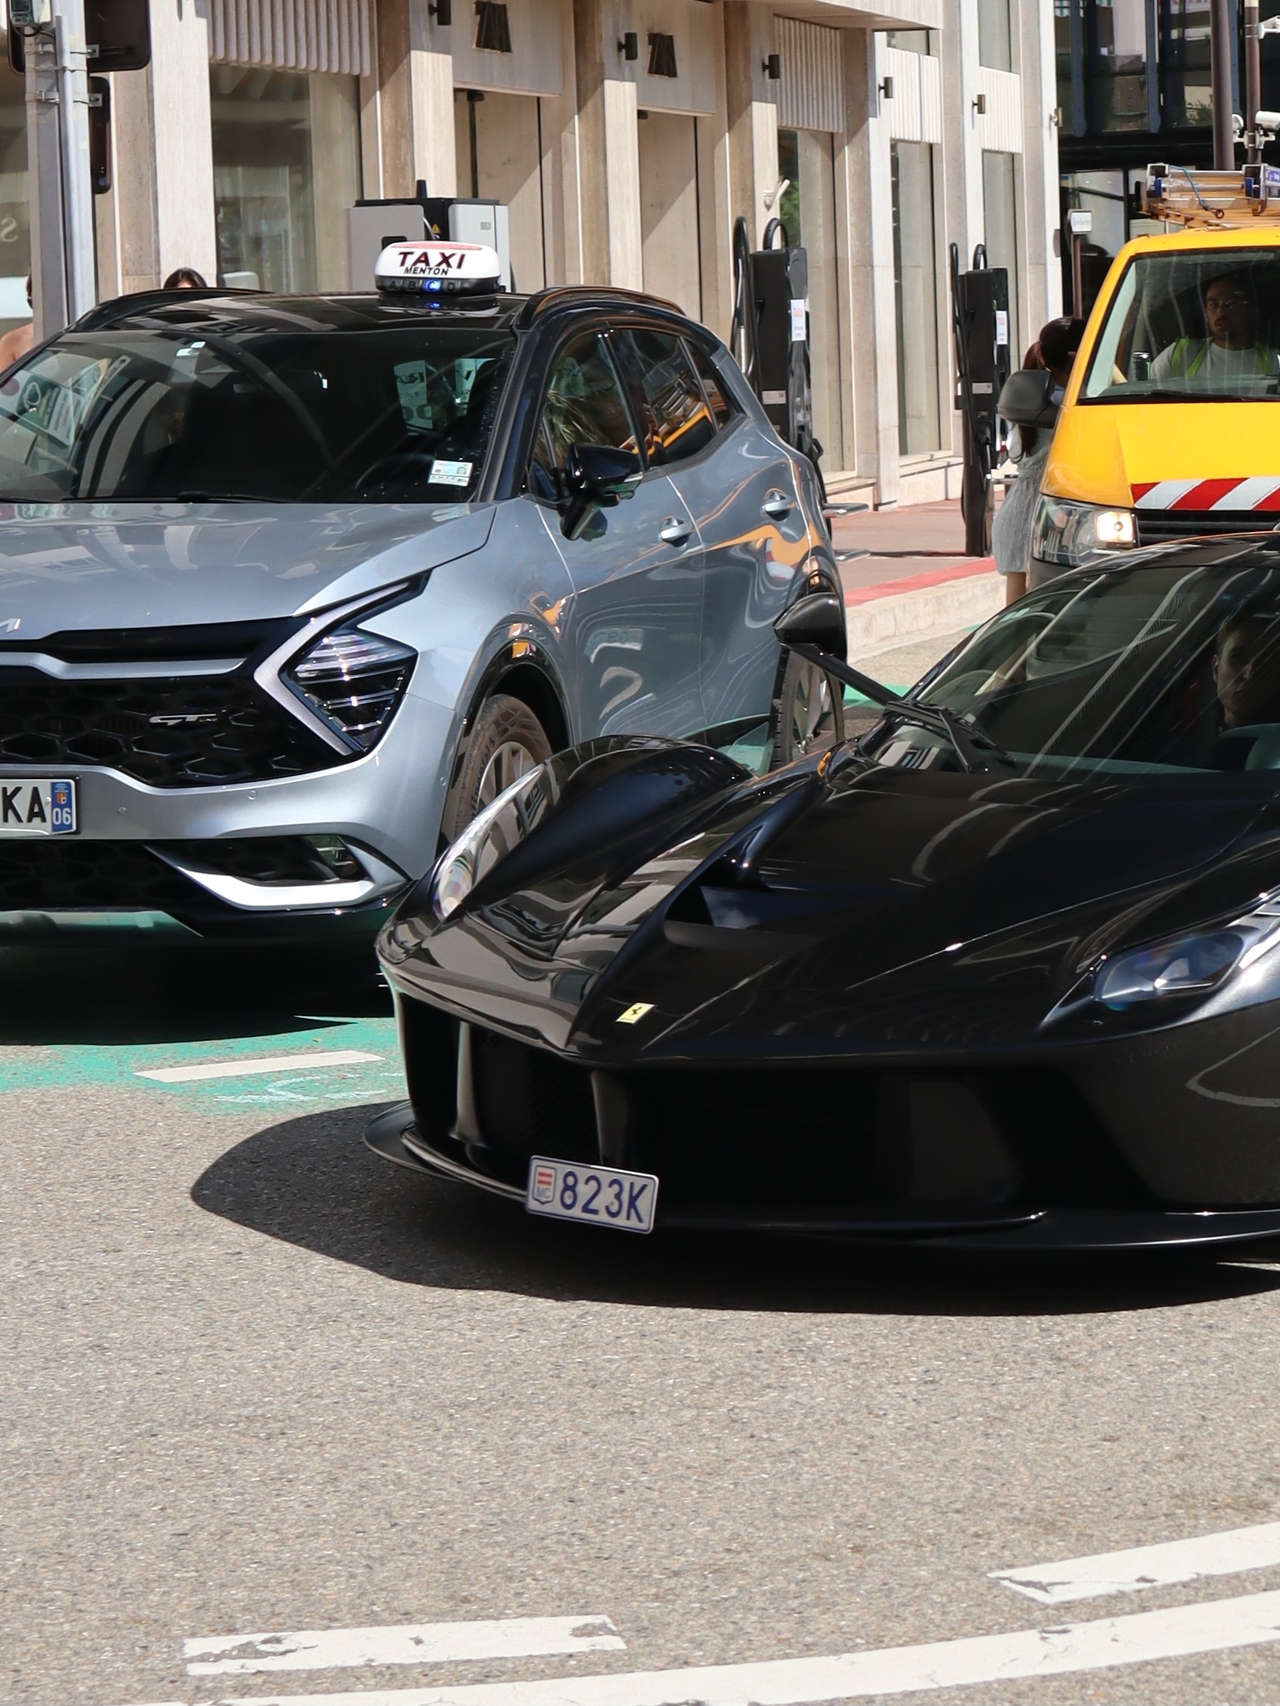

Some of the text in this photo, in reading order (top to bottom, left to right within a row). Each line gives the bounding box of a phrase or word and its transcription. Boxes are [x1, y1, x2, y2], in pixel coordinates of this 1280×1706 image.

[398, 251, 466, 270] TAXI
[404, 266, 449, 276] MENTON
[52, 807, 72, 826] 06
[536, 1186, 551, 1199] MC
[559, 1170, 648, 1224] 823K
